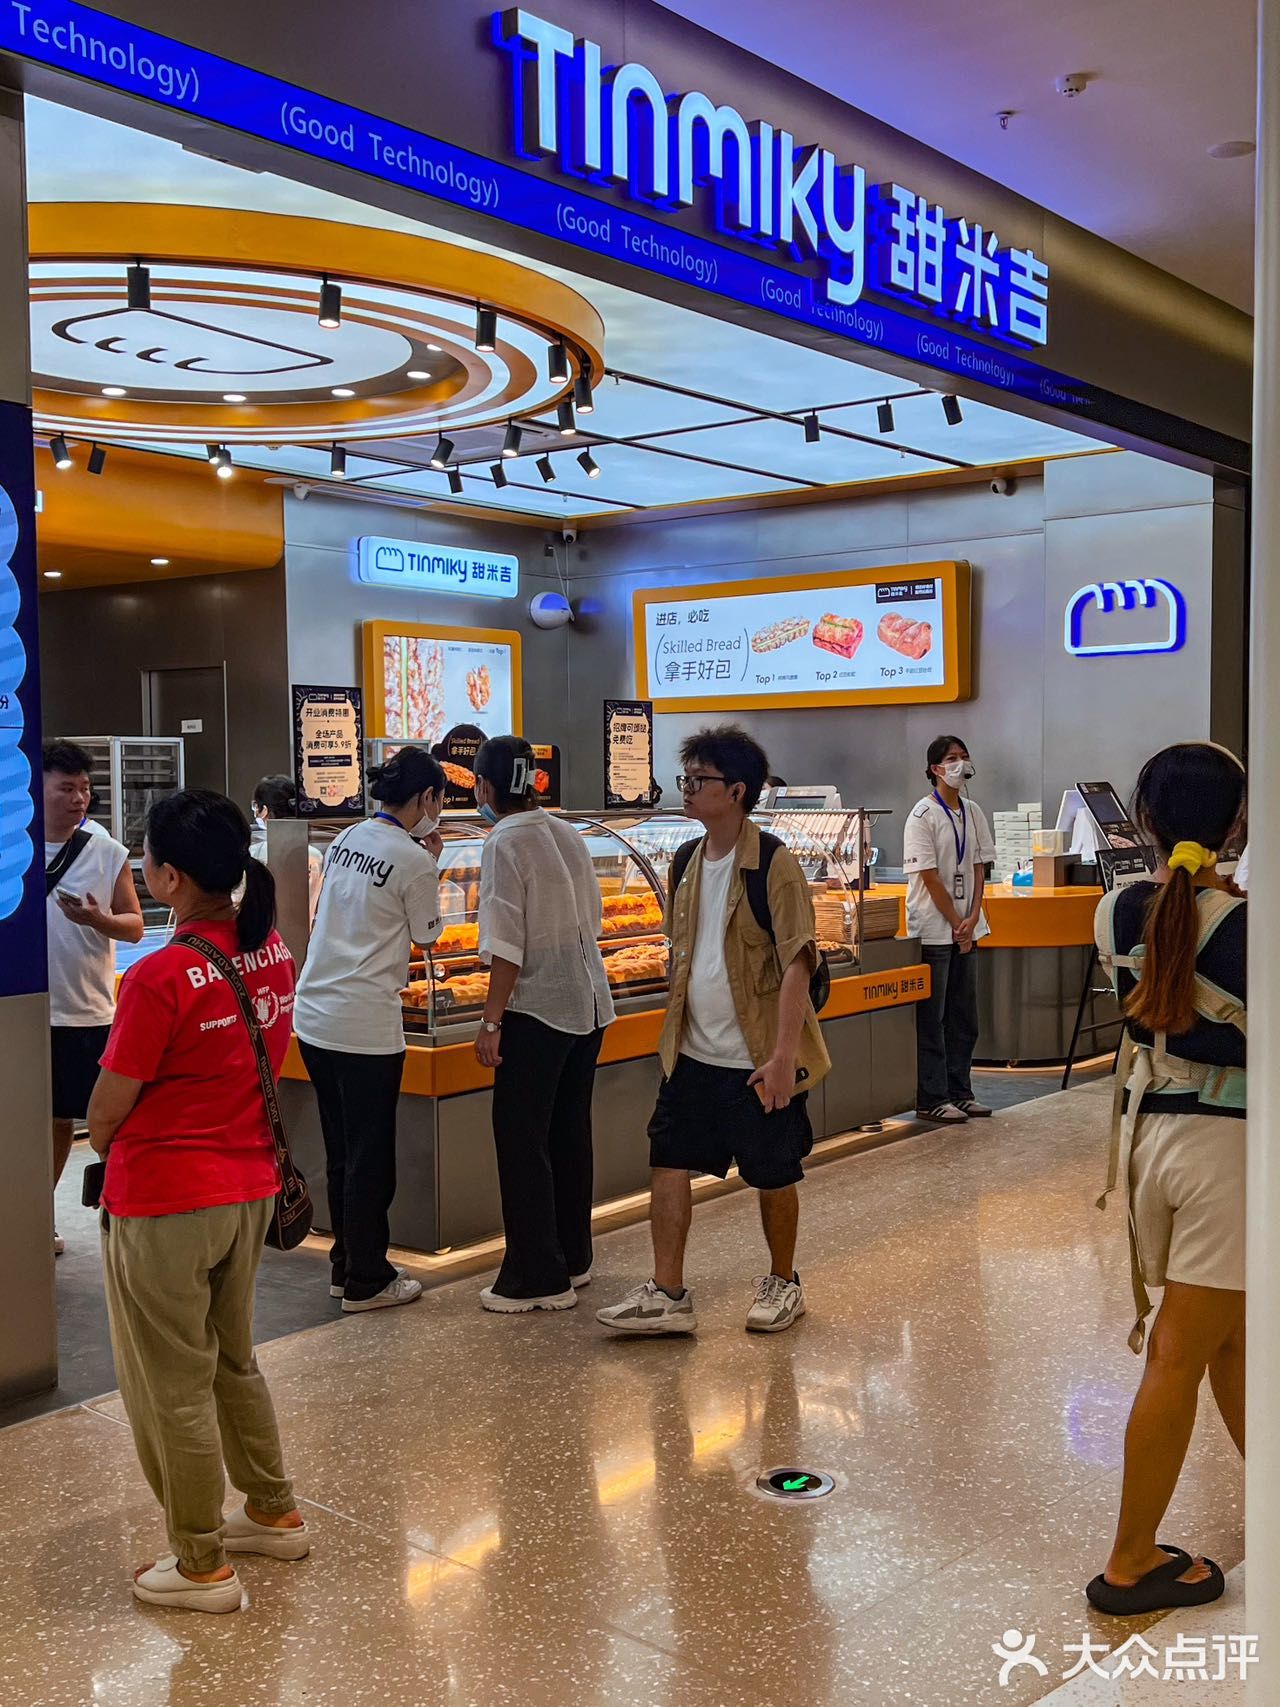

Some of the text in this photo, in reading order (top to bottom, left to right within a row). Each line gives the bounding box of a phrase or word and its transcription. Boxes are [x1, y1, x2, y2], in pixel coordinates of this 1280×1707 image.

[12, 1, 200, 103] Technology)
[281, 102, 499, 208] (Good Technology)
[556, 203, 719, 284] (Good Technology)
[891, 182, 1050, 347] 甜米吉
[761, 276, 801, 309] (Good
[916, 333, 950, 360] (Good
[472, 561, 512, 583] 甜米吉
[662, 635, 742, 655] Skilled Bread
[664, 658, 731, 682] 拿手好包
[755, 674, 771, 686] Top
[815, 671, 832, 683] Top
[832, 670, 839, 679] 2
[880, 667, 897, 679] Top
[898, 666, 904, 675] 3
[315, 729, 344, 739] 全场产品
[900, 976, 925, 994] 甜米吉
[200, 1014, 238, 1032] SUPPORTS
